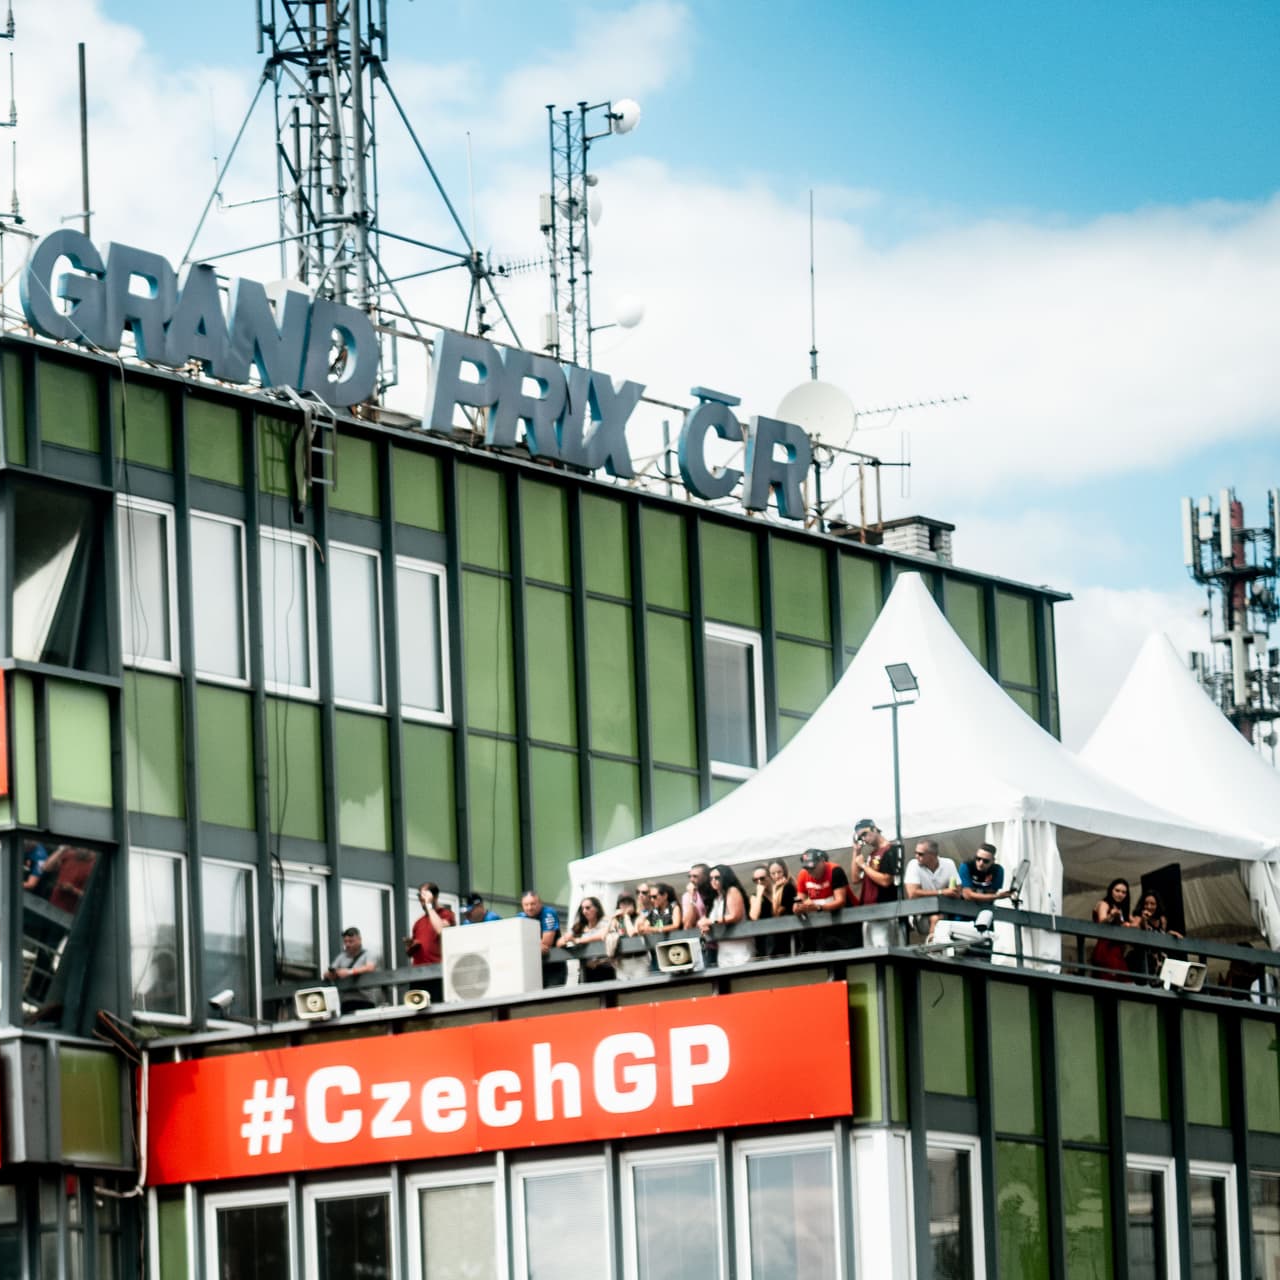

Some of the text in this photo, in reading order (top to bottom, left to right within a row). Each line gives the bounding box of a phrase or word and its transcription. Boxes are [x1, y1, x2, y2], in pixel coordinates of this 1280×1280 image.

[19, 227, 381, 408] GRAND
[423, 330, 647, 479] PRIX
[679, 387, 813, 521] ČR
[241, 1024, 731, 1157] #CzechGP
